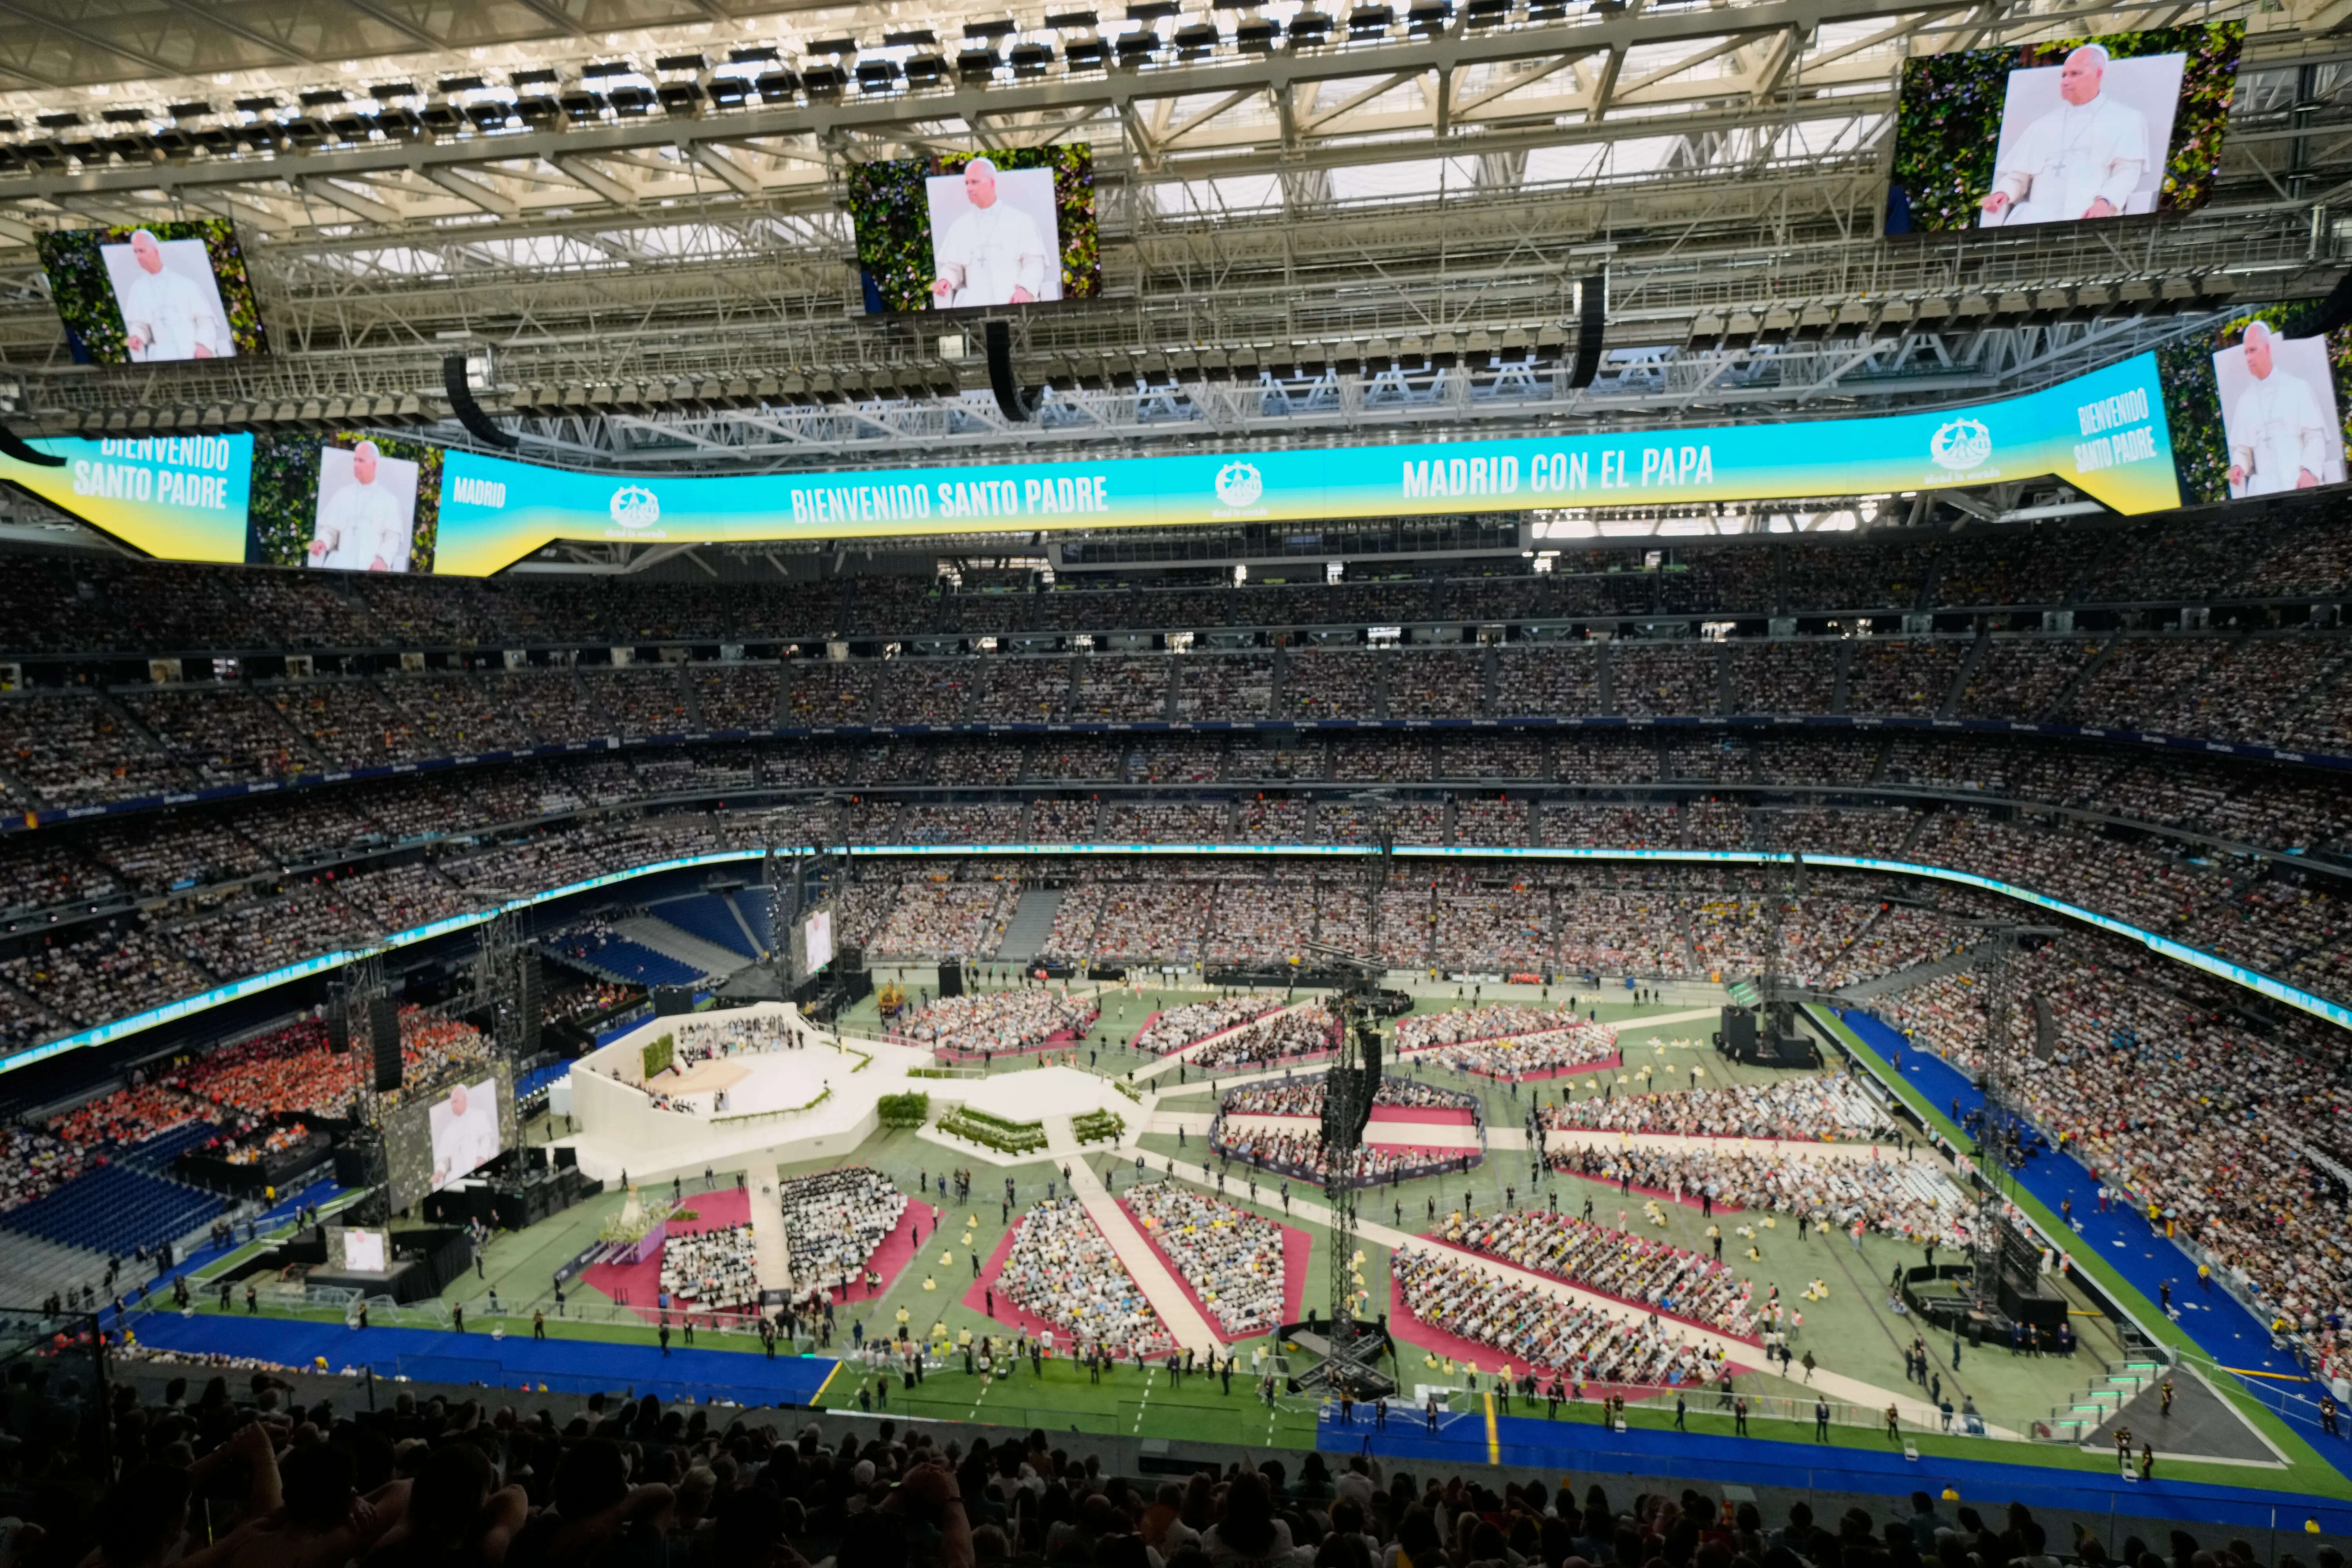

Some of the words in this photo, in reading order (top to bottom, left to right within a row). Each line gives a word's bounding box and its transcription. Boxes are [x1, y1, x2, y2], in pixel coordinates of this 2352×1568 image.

[2078, 387, 2149, 436] BIENVENIDO
[1403, 455, 1520, 498] MADRID
[1530, 452, 1588, 492] CON
[1601, 450, 1629, 489] EL
[1641, 445, 1713, 487] PAPA
[2074, 437, 2113, 474] SANTO
[2111, 425, 2157, 465] PADRE
[73, 460, 152, 501] SANTO
[157, 470, 228, 509] PADRE
[453, 476, 506, 508] MADRID
[790, 483, 930, 523] BIENVENIDO
[939, 479, 1018, 517] SANTO
[1025, 476, 1108, 514] PADRE
